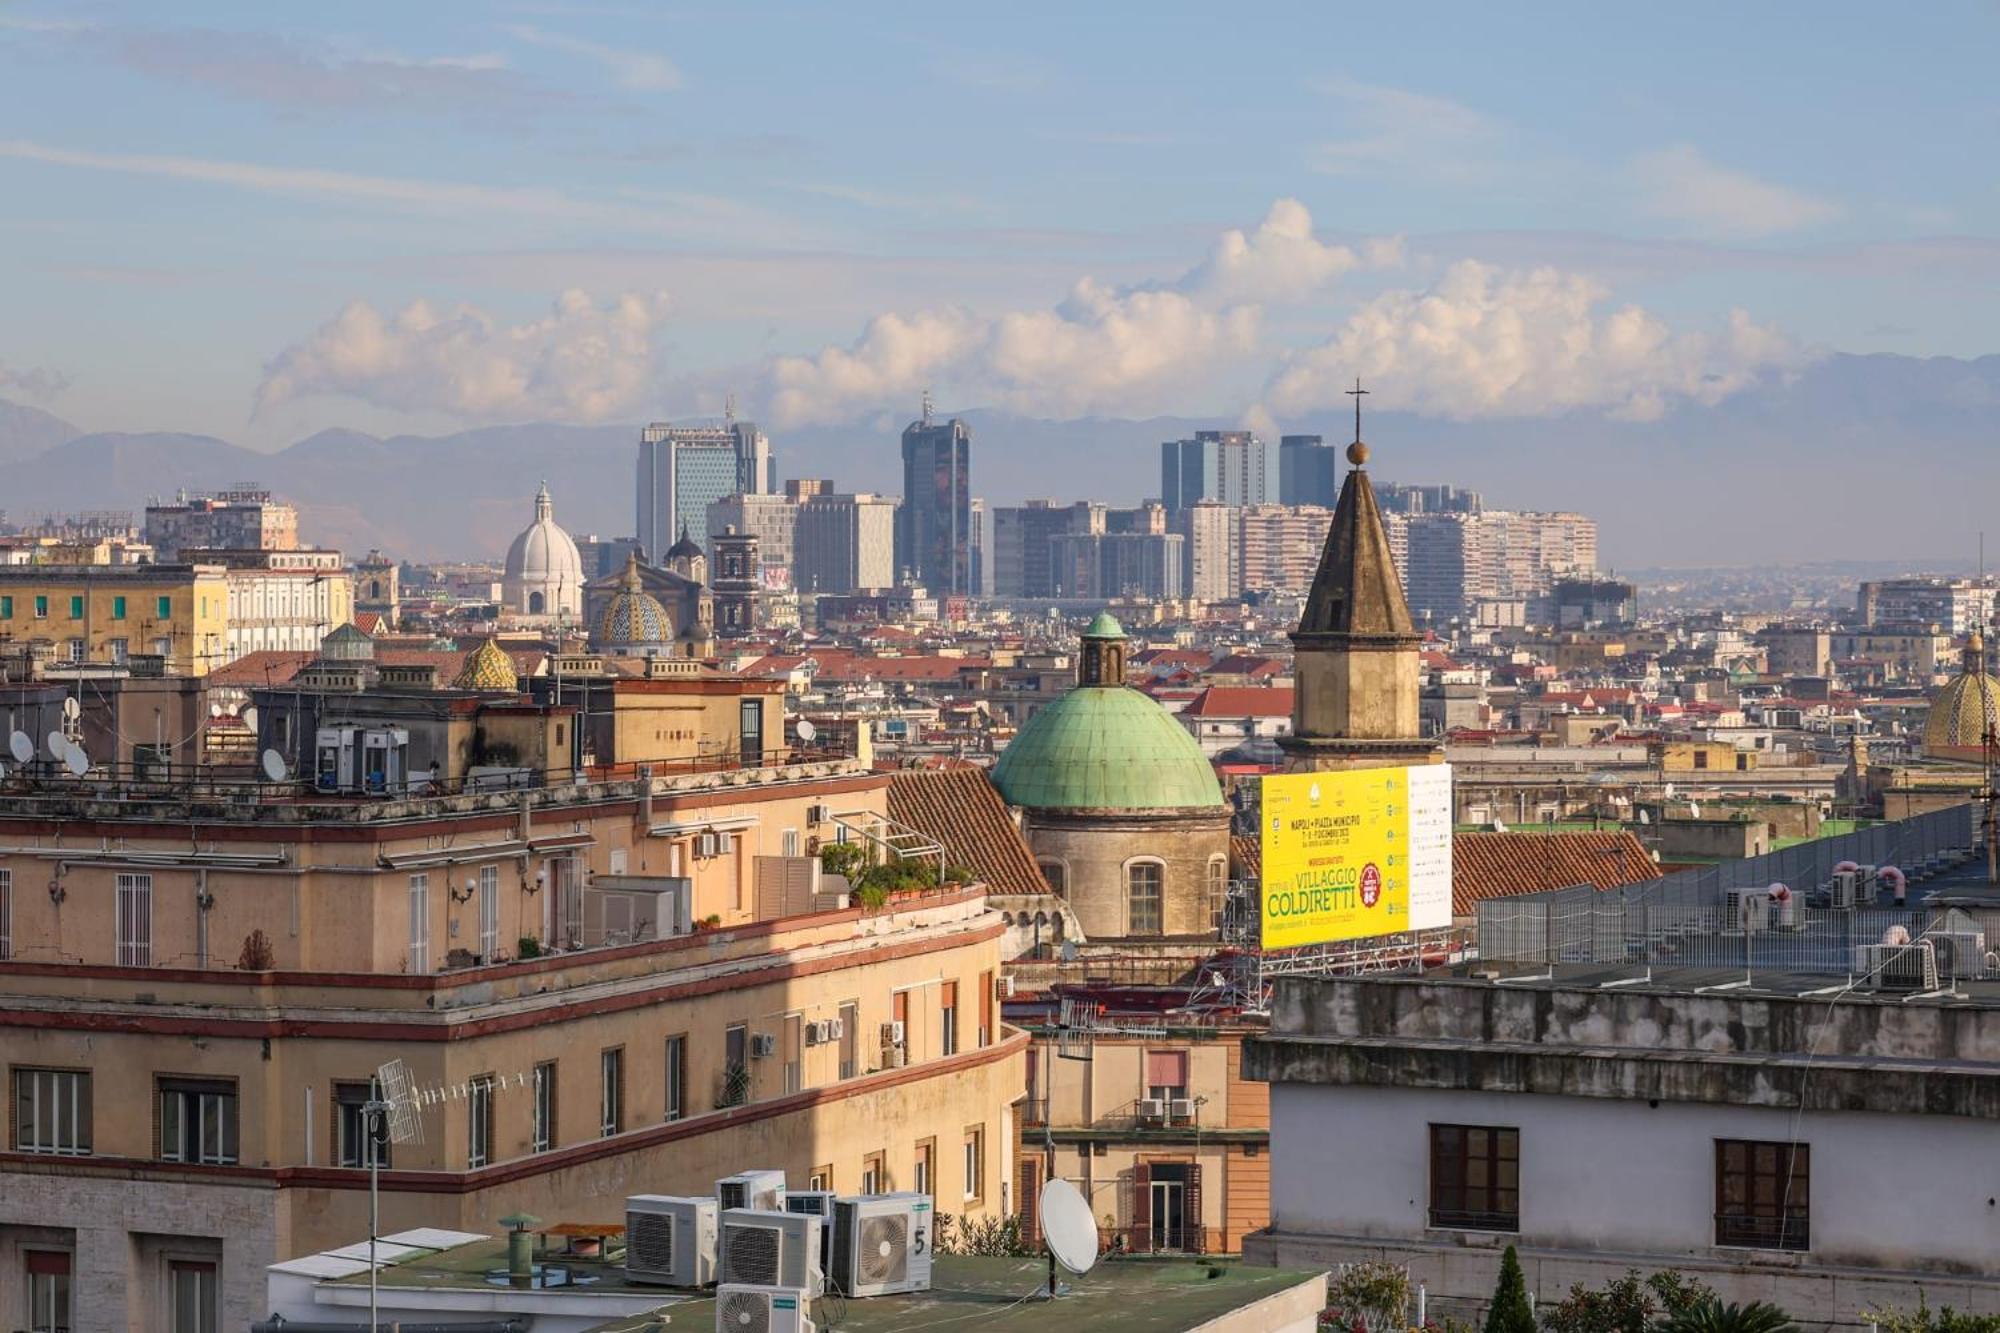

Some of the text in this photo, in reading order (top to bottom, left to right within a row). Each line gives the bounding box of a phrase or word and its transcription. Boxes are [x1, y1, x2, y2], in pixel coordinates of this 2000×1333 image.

[1291, 814, 1360, 831] NAPOLI PIAZZA MUNICIPIO
[1296, 868, 1357, 889] VILLAGGIO
[1267, 886, 1355, 917] COLDIRETTI
[914, 1229, 925, 1255] 5
